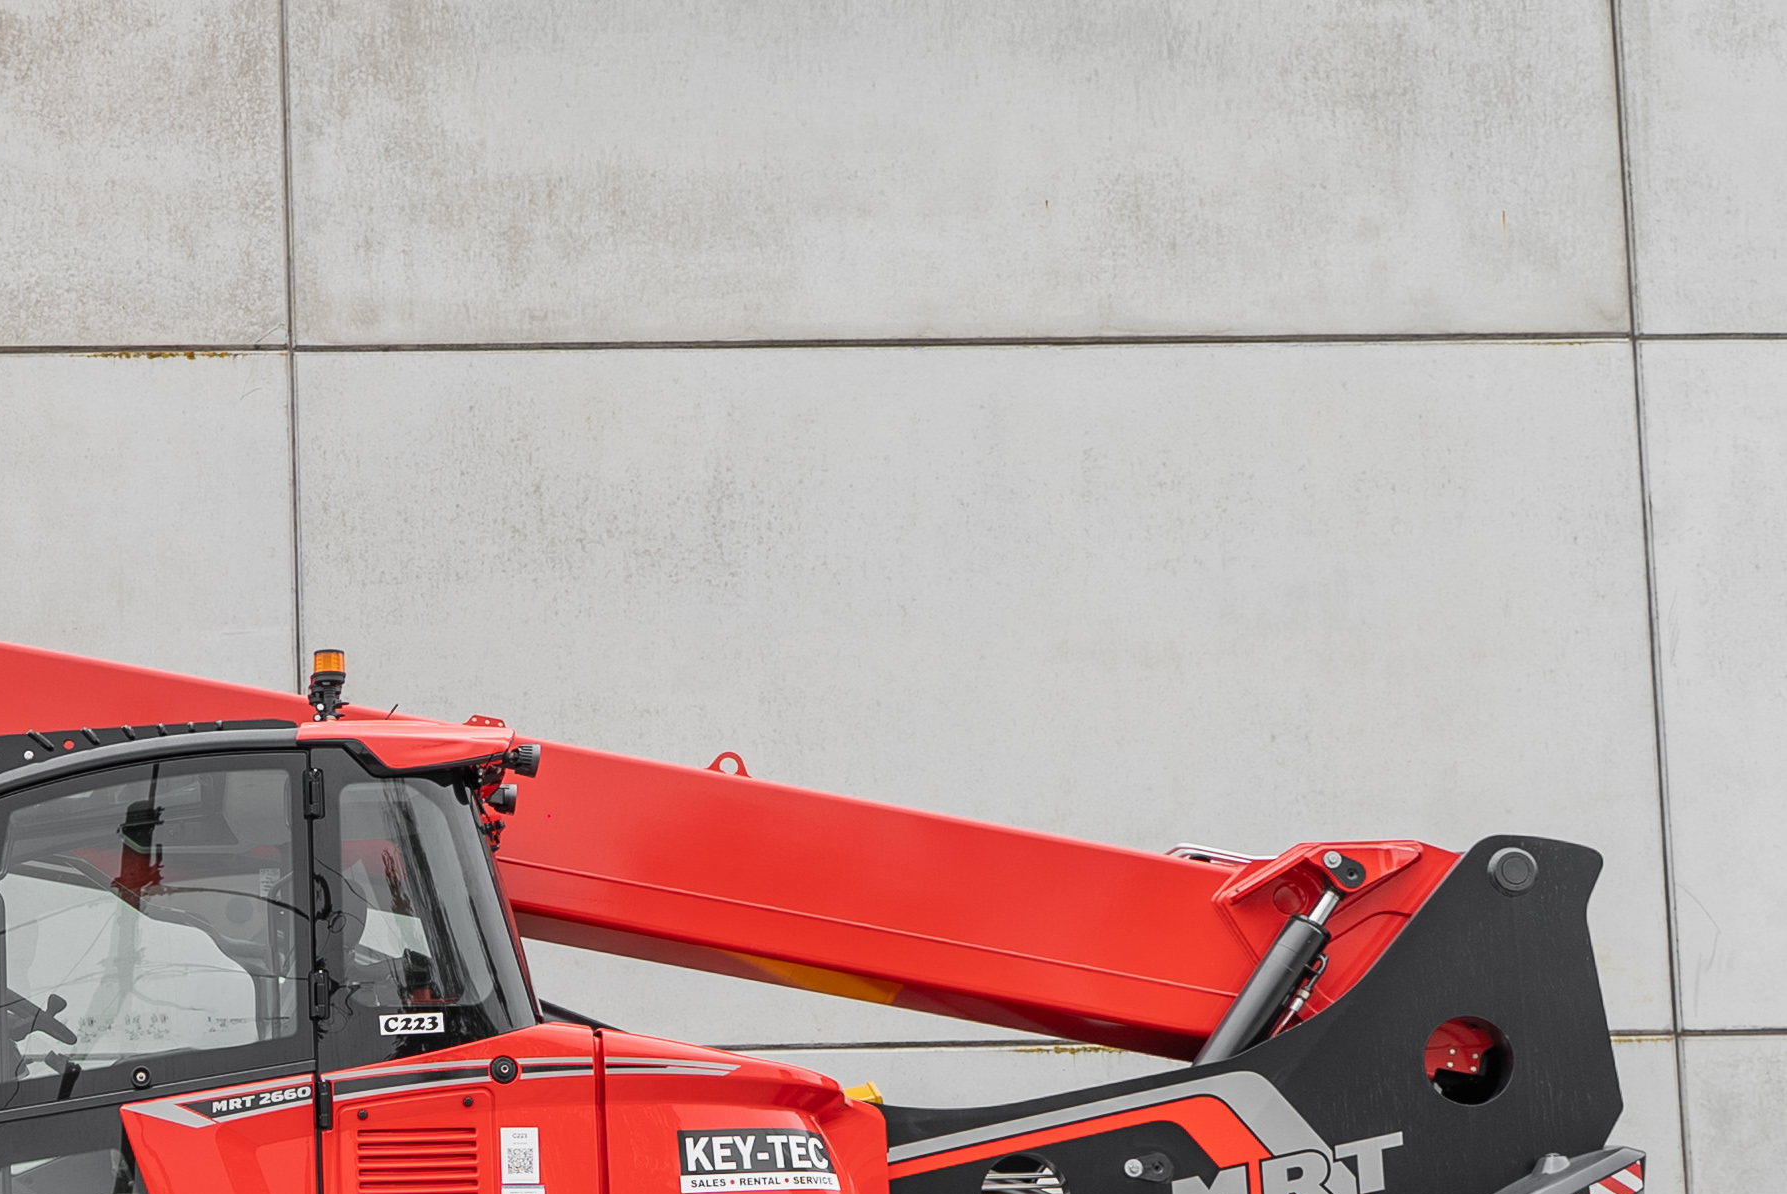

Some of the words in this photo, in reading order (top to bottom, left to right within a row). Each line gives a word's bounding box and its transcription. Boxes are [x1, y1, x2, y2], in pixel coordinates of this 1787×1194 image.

[384, 1016, 439, 1033] C223
[212, 1095, 255, 1113] MRT
[259, 1086, 312, 1105] 2660
[685, 1135, 829, 1172] KEY-TEC
[690, 1178, 727, 1188] SALES
[739, 1176, 781, 1187] RENTAL
[793, 1175, 834, 1186] SERVICE
